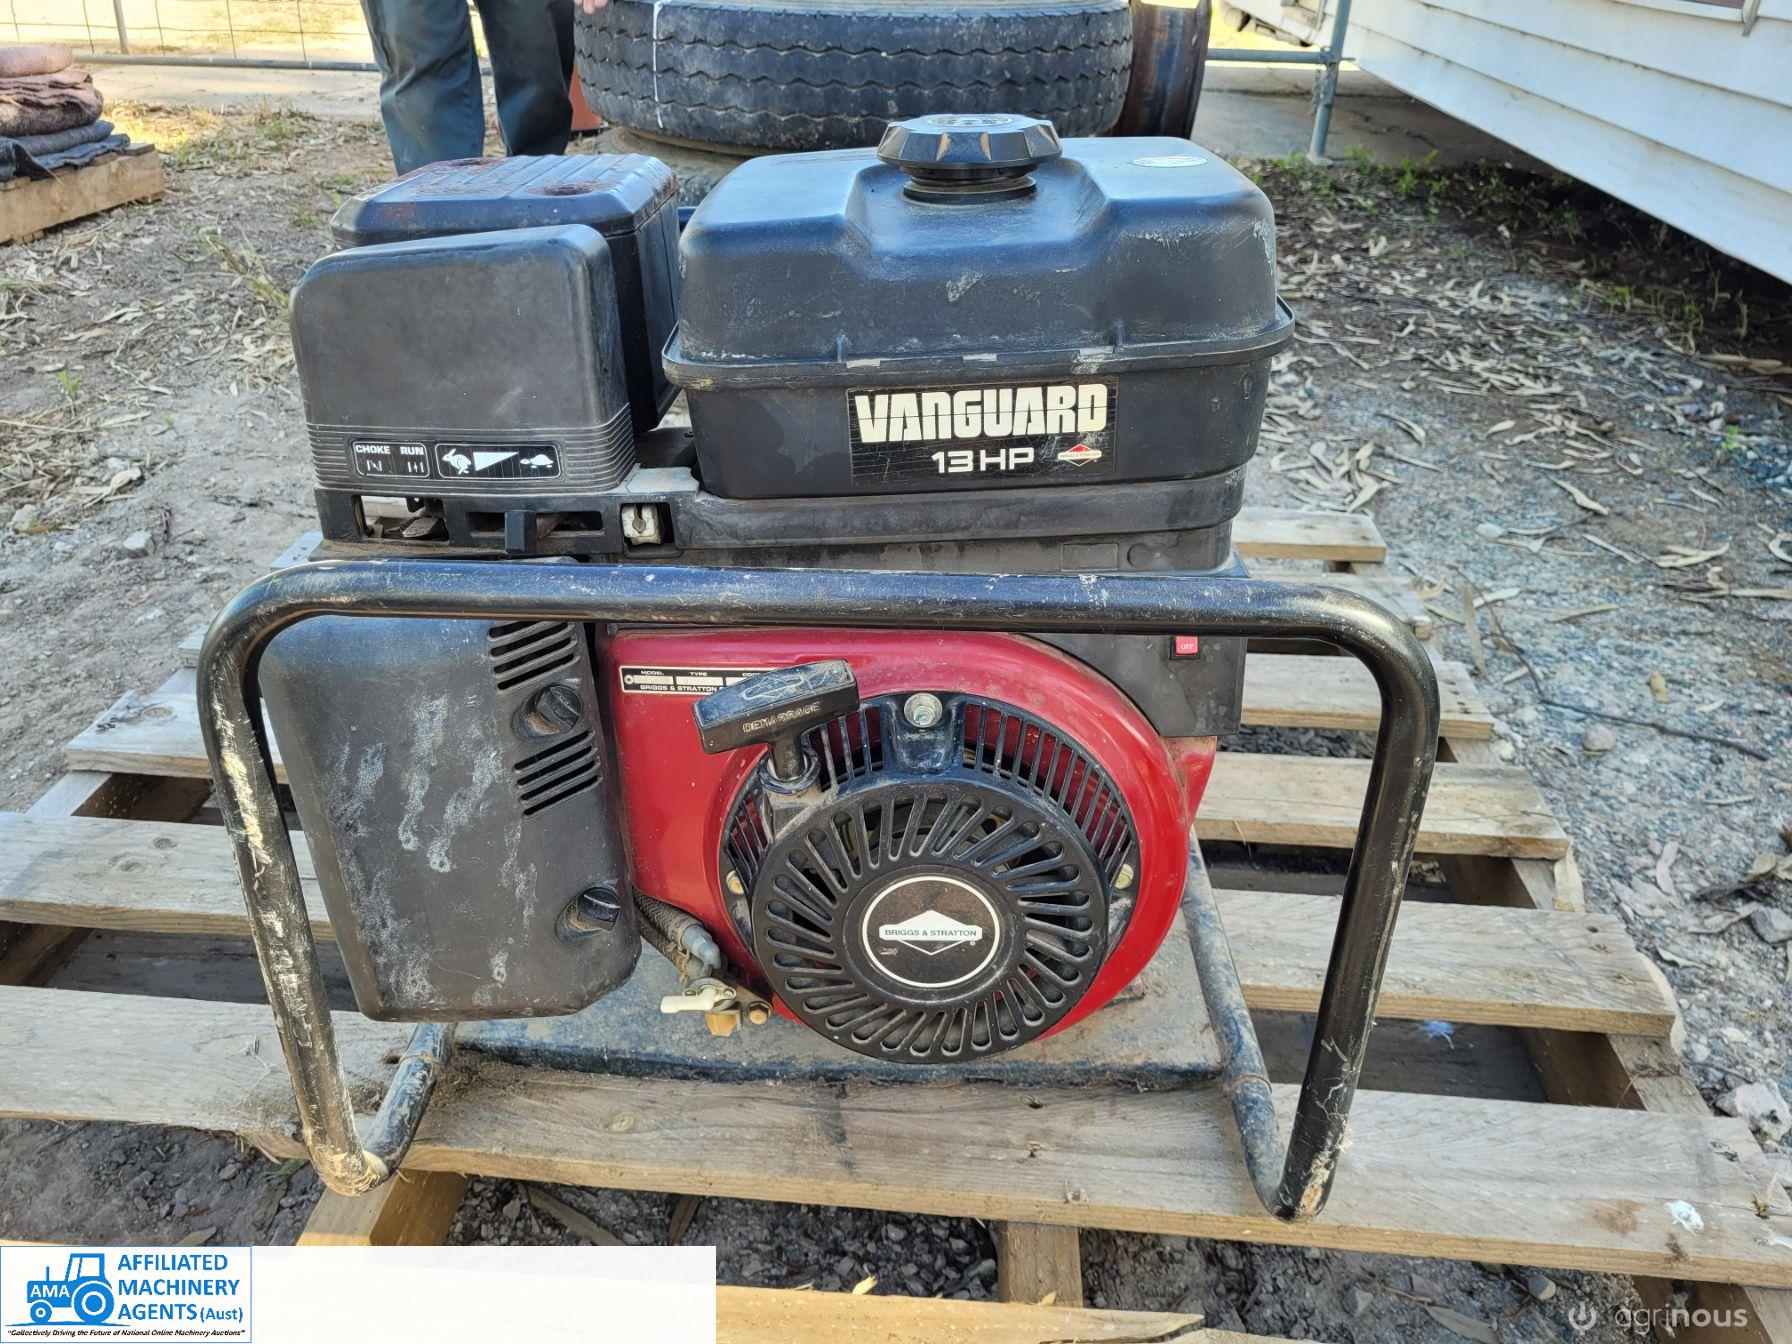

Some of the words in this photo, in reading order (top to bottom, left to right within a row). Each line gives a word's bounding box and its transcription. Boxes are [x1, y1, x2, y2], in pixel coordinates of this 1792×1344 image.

[855, 383, 1108, 443] VANGUARD
[355, 444, 390, 455] CHOKE
[400, 446, 424, 456] RUN
[931, 450, 974, 473] 13
[980, 447, 1035, 471] HP
[742, 701, 821, 733] DEMARRAGE
[930, 929, 977, 937] STRATTON
